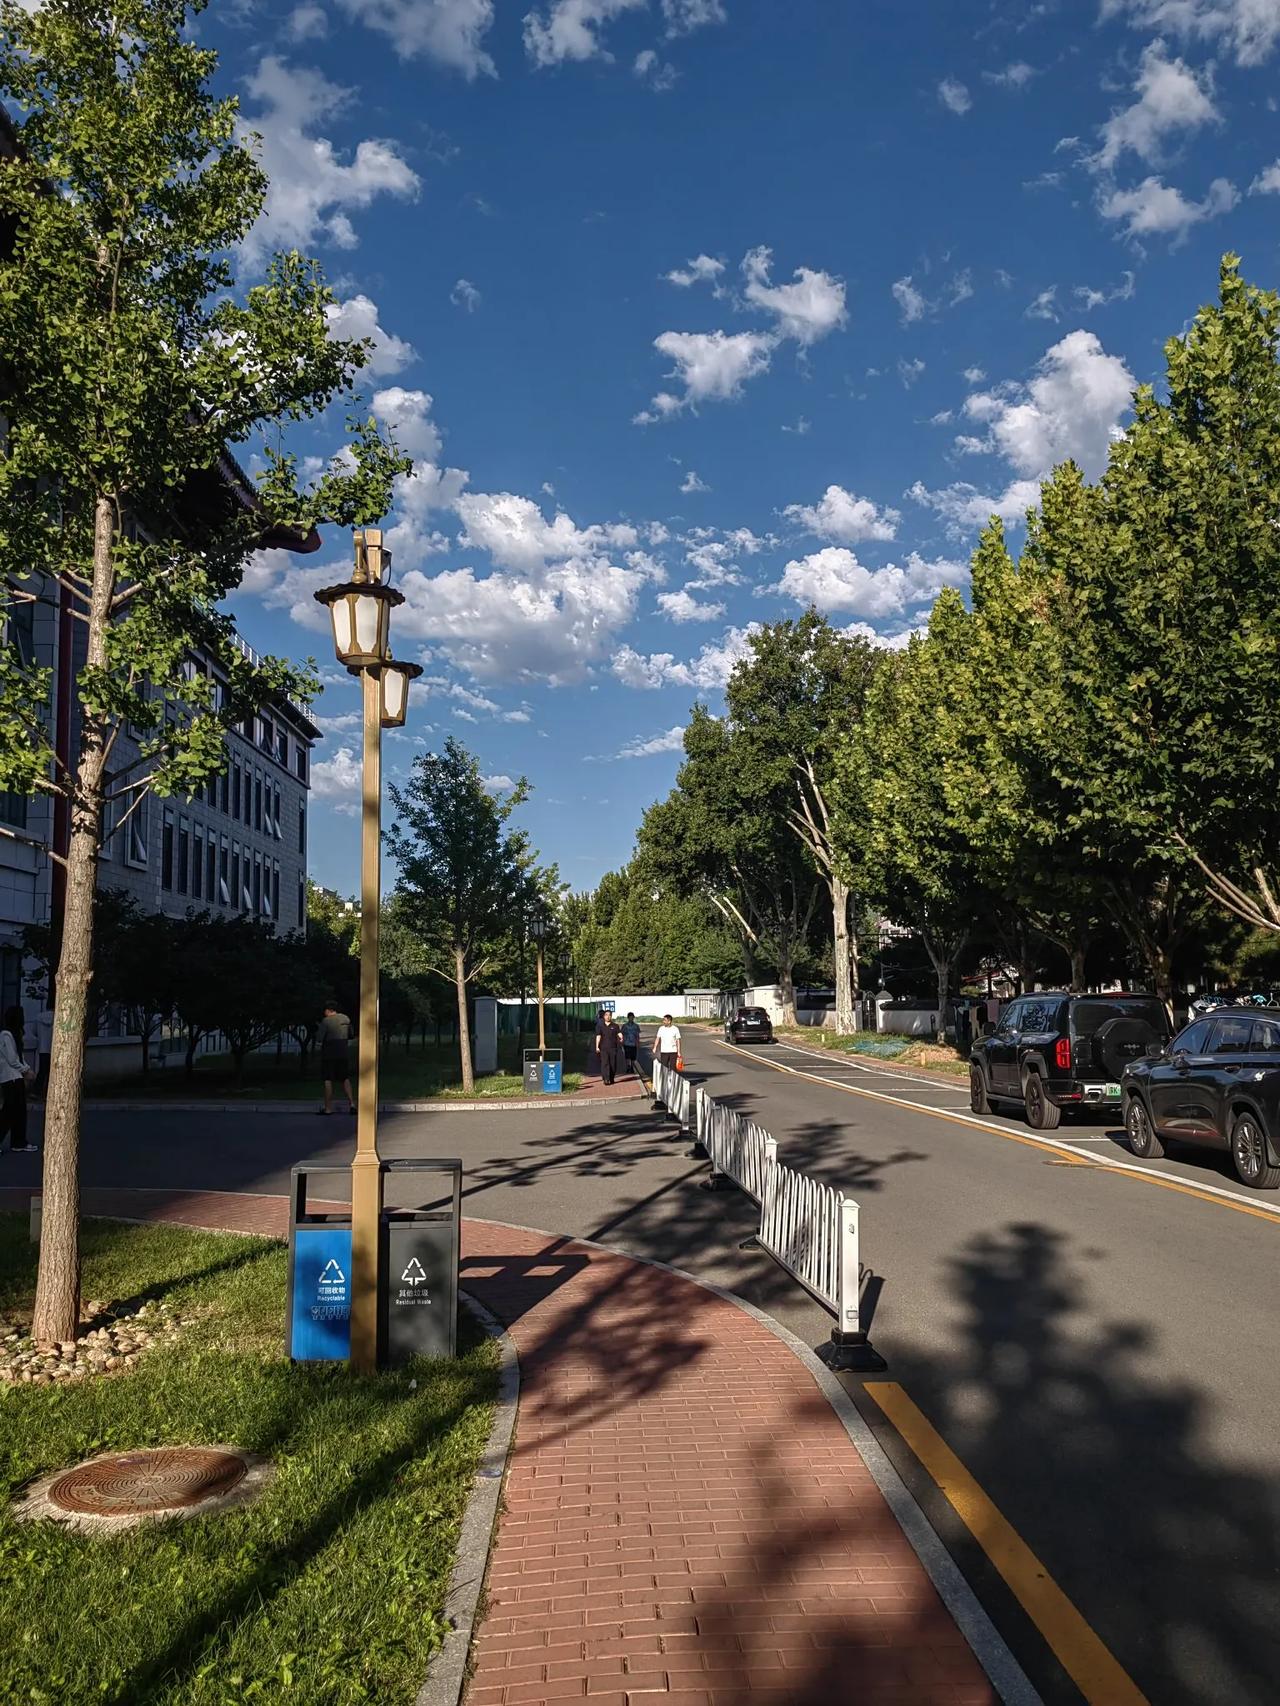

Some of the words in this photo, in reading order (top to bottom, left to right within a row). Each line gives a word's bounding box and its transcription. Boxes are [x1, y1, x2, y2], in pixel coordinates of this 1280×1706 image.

[318, 1286, 346, 1295] 可回收物
[399, 1289, 430, 1298] 其他垃圾
